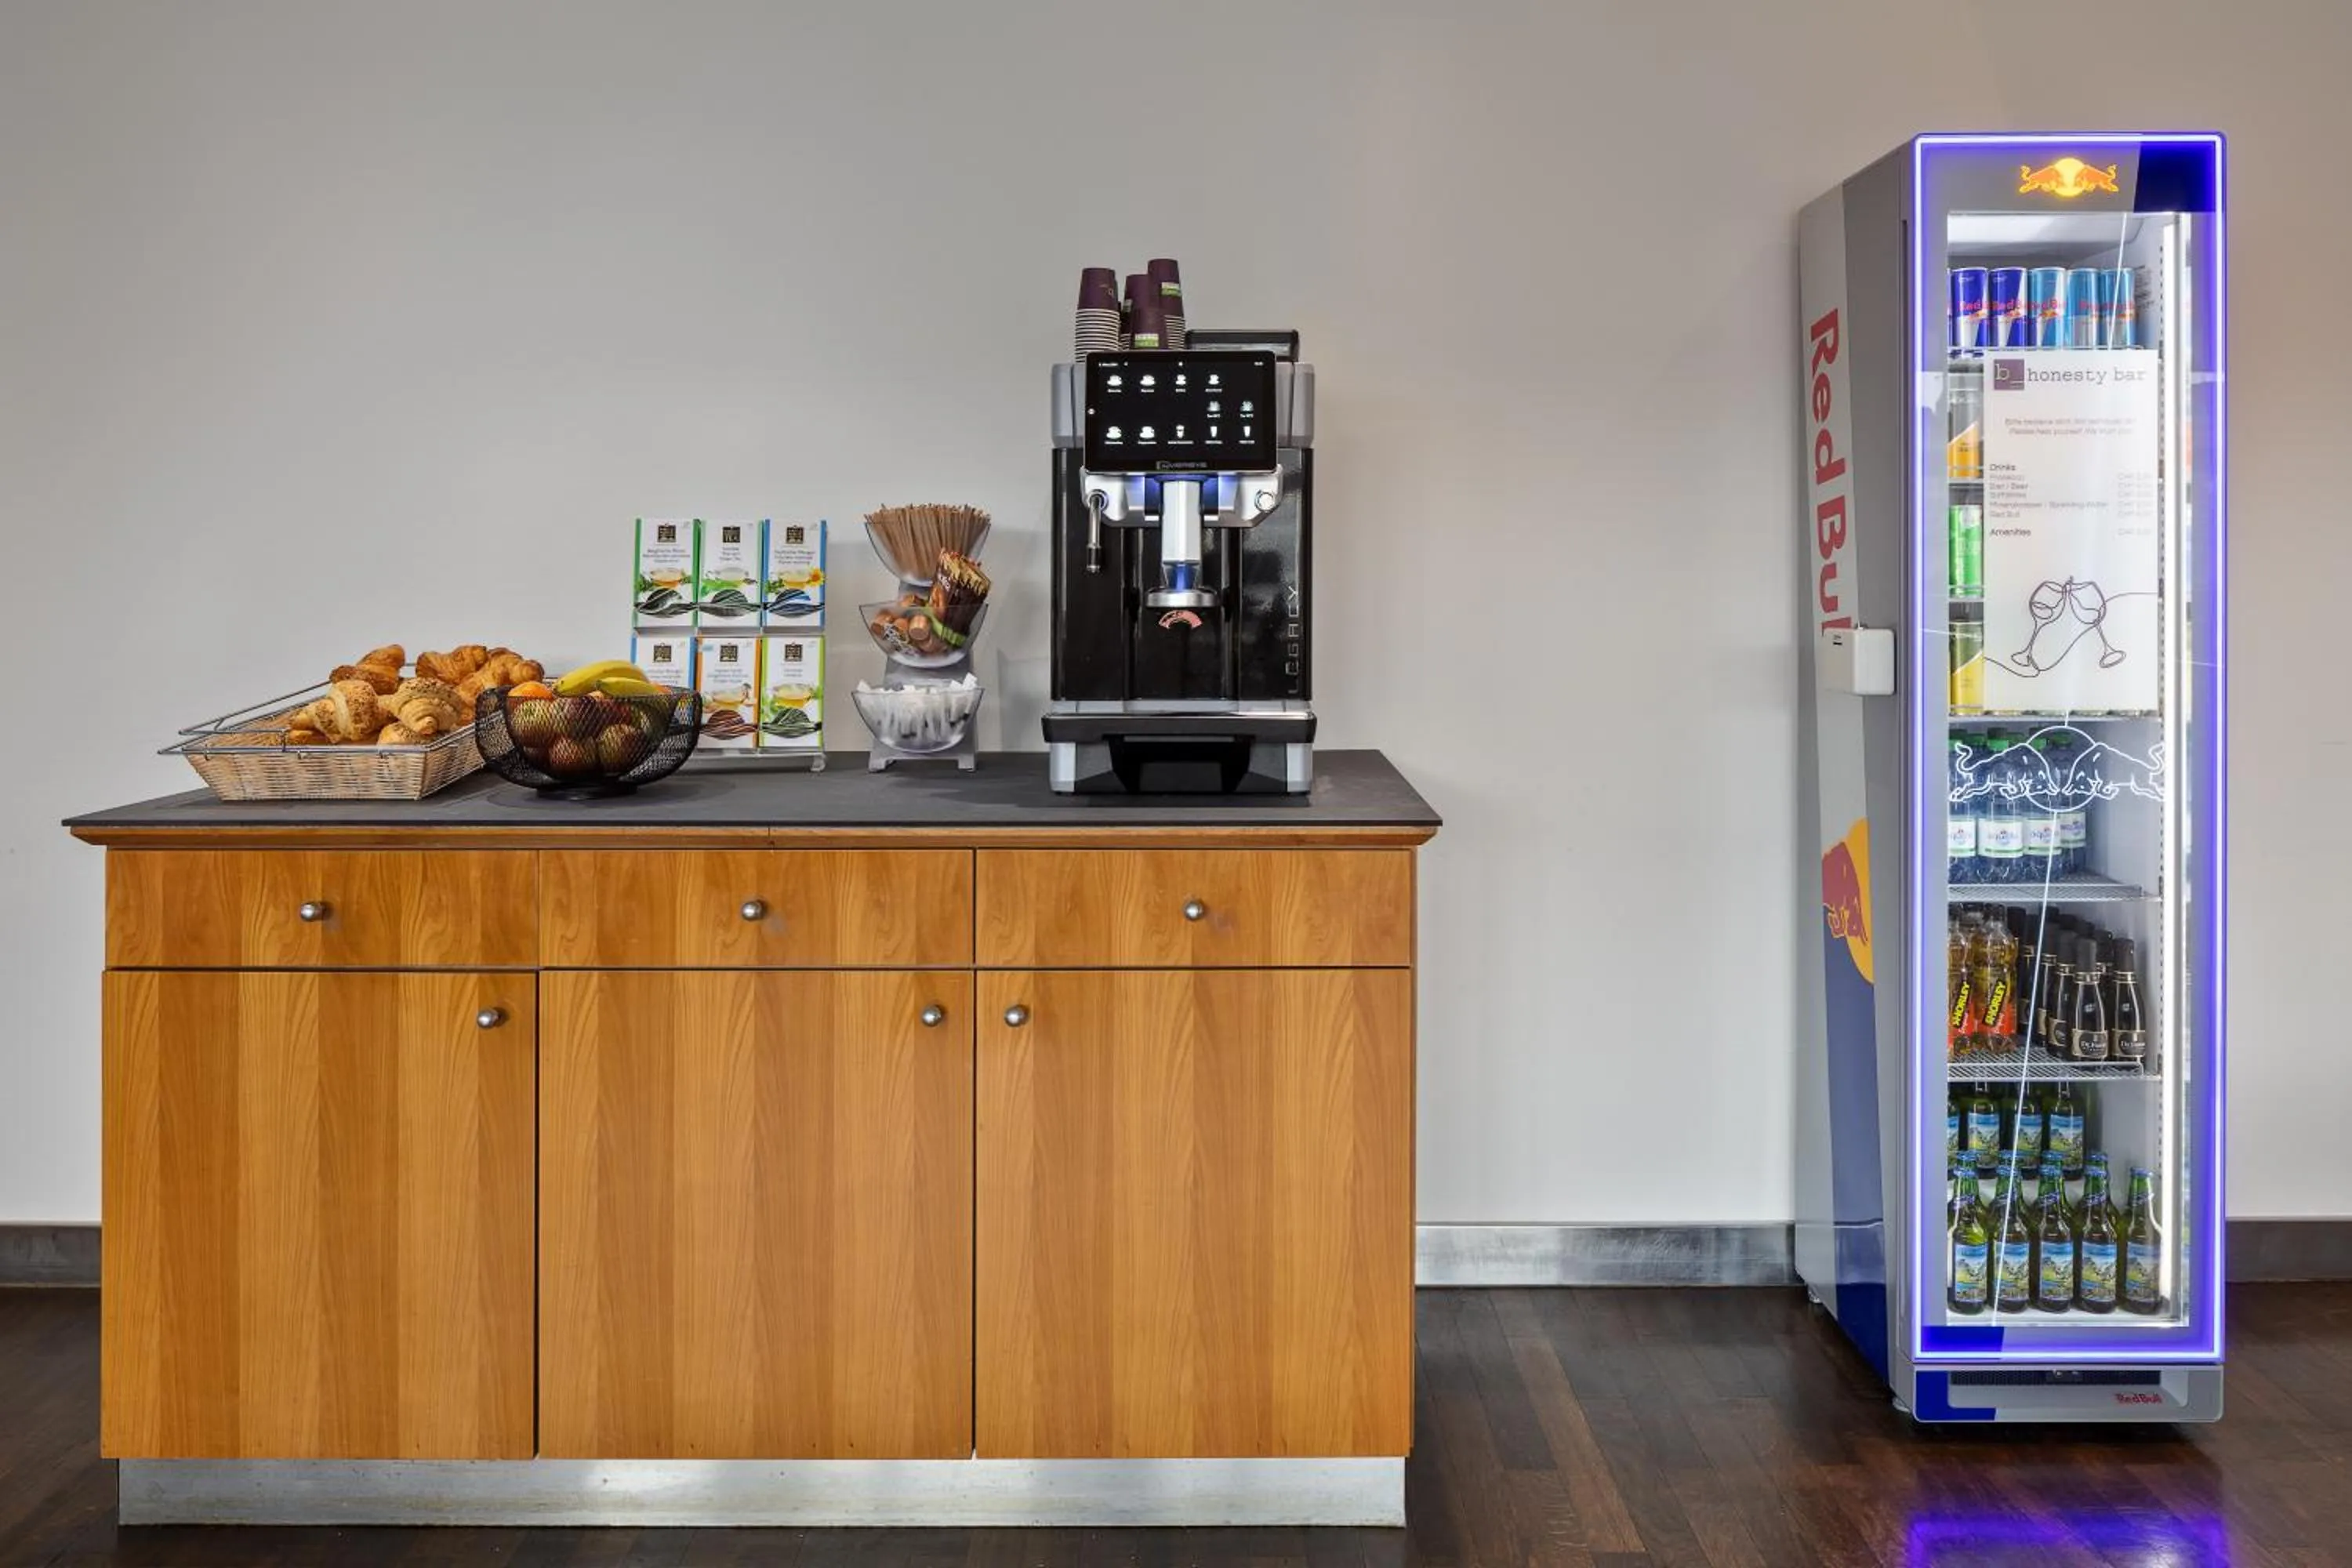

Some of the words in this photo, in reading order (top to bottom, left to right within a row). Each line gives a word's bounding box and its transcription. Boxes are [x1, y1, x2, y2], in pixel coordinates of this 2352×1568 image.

[1810, 308, 1846, 485] Red
[2027, 367, 2107, 385] honesty
[2113, 366, 2147, 382] bar
[1817, 495, 1852, 637] Bul
[1989, 528, 2031, 537] Amenities
